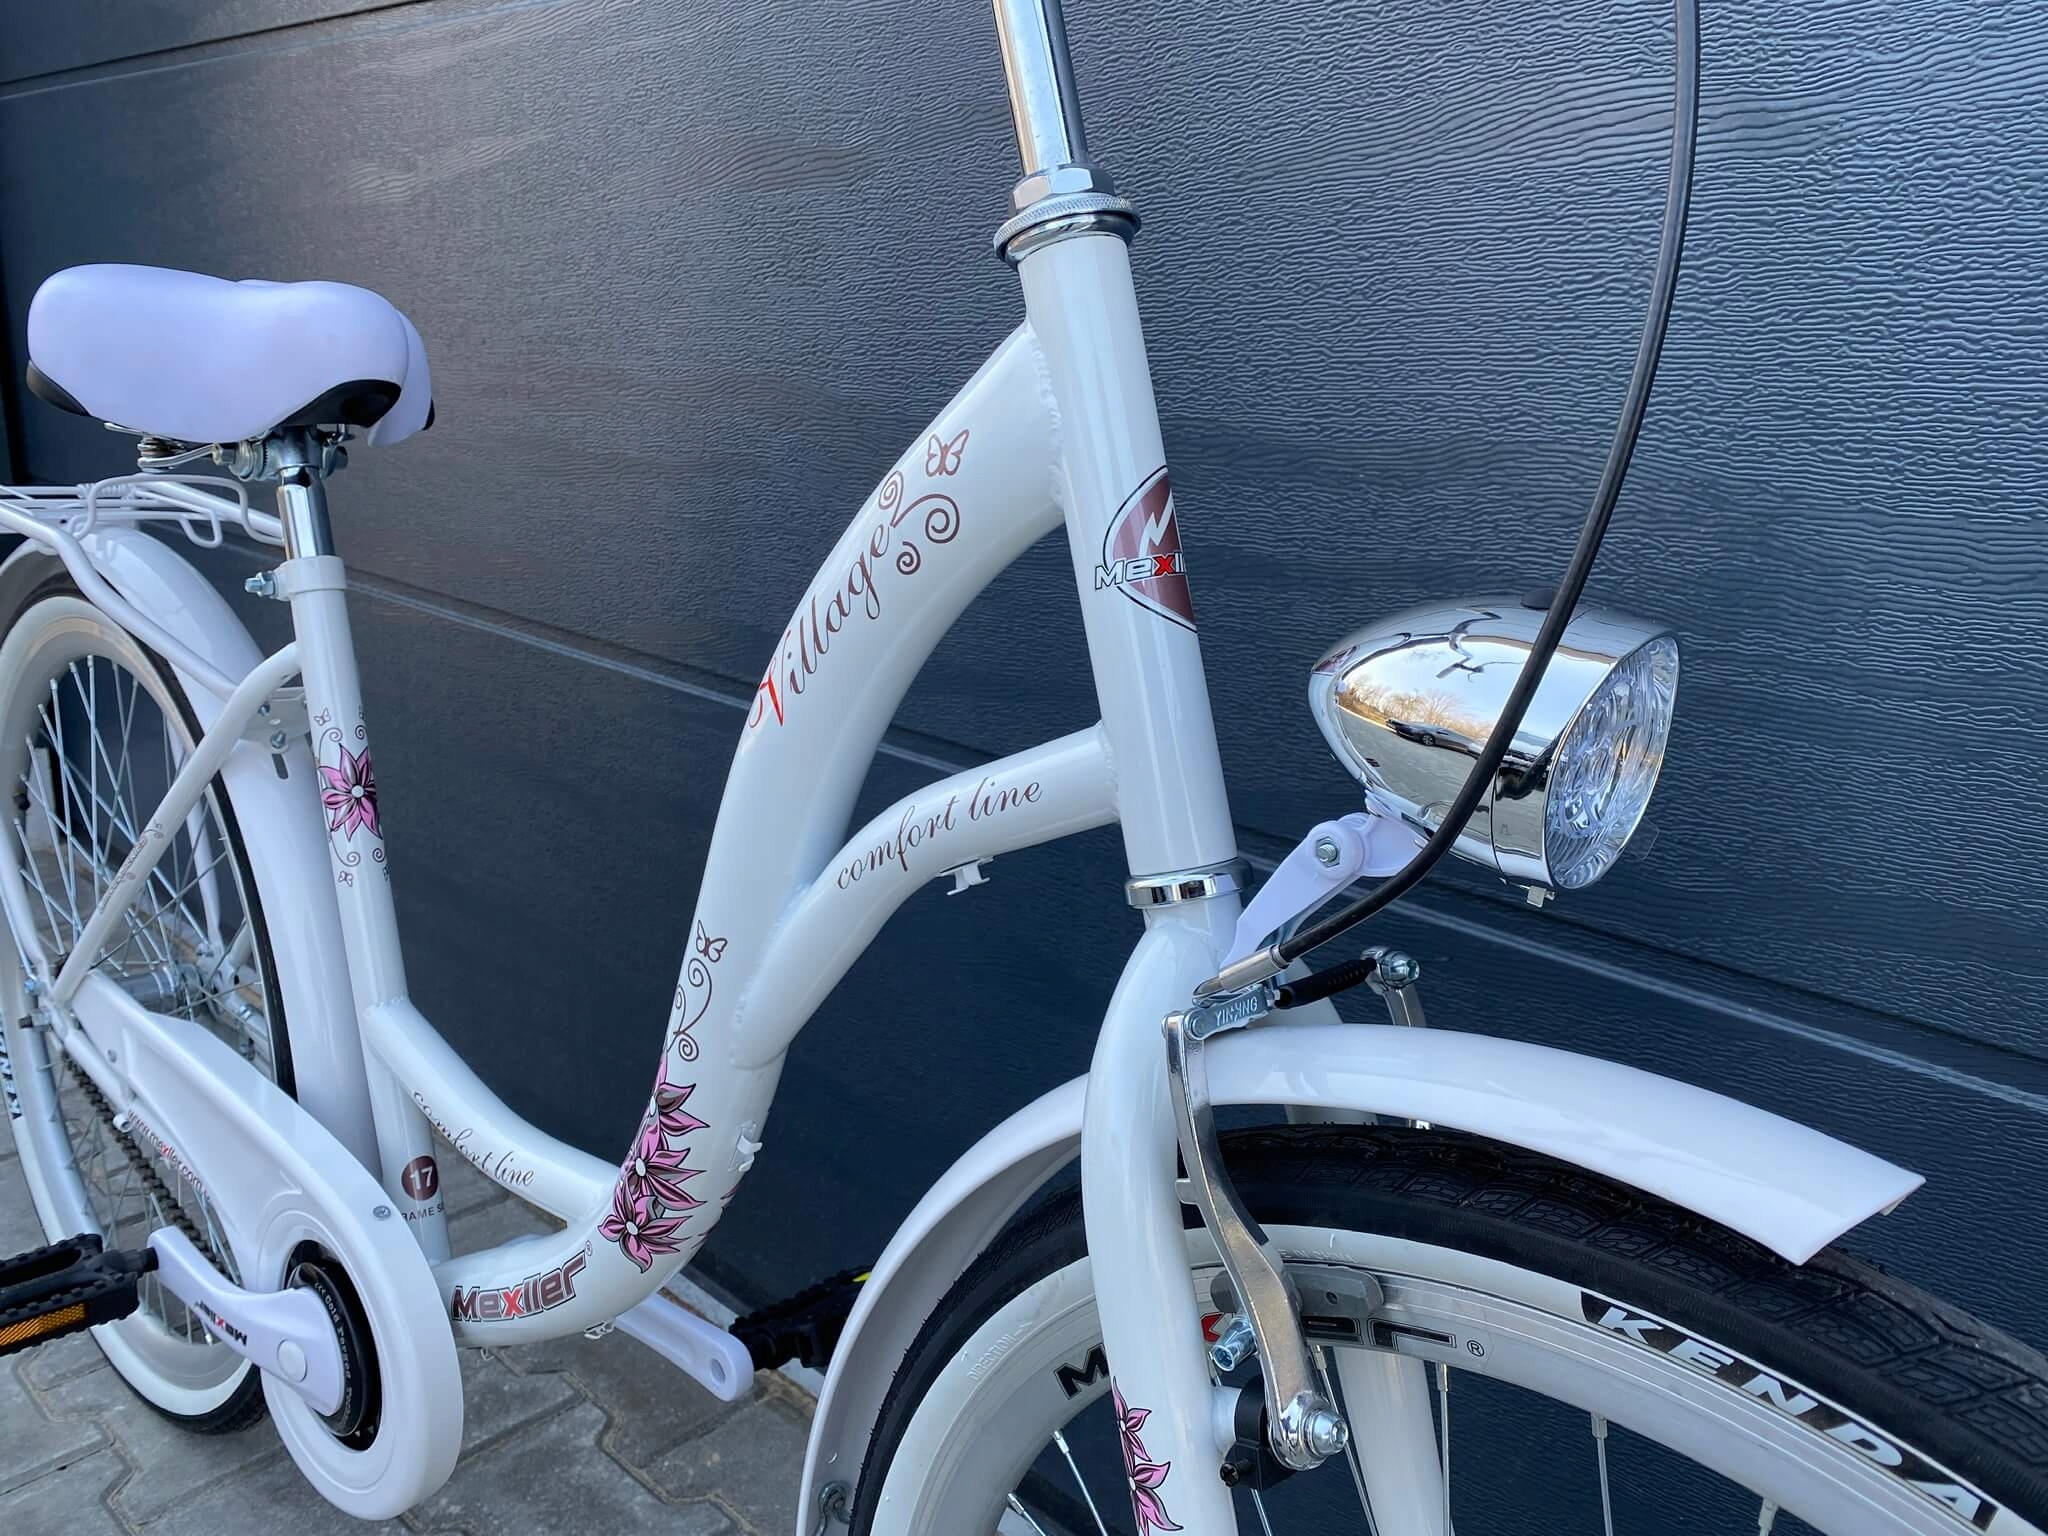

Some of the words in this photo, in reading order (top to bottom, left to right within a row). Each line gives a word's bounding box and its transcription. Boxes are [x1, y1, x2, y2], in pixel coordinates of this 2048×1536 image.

[748, 523, 890, 728] Village
[837, 795, 960, 889] comfort
[968, 776, 1044, 822] line
[409, 1166, 433, 1190] 17
[494, 1150, 537, 1188] line
[451, 1249, 587, 1322] Mexller
[1597, 1307, 1983, 1520] KENDA
